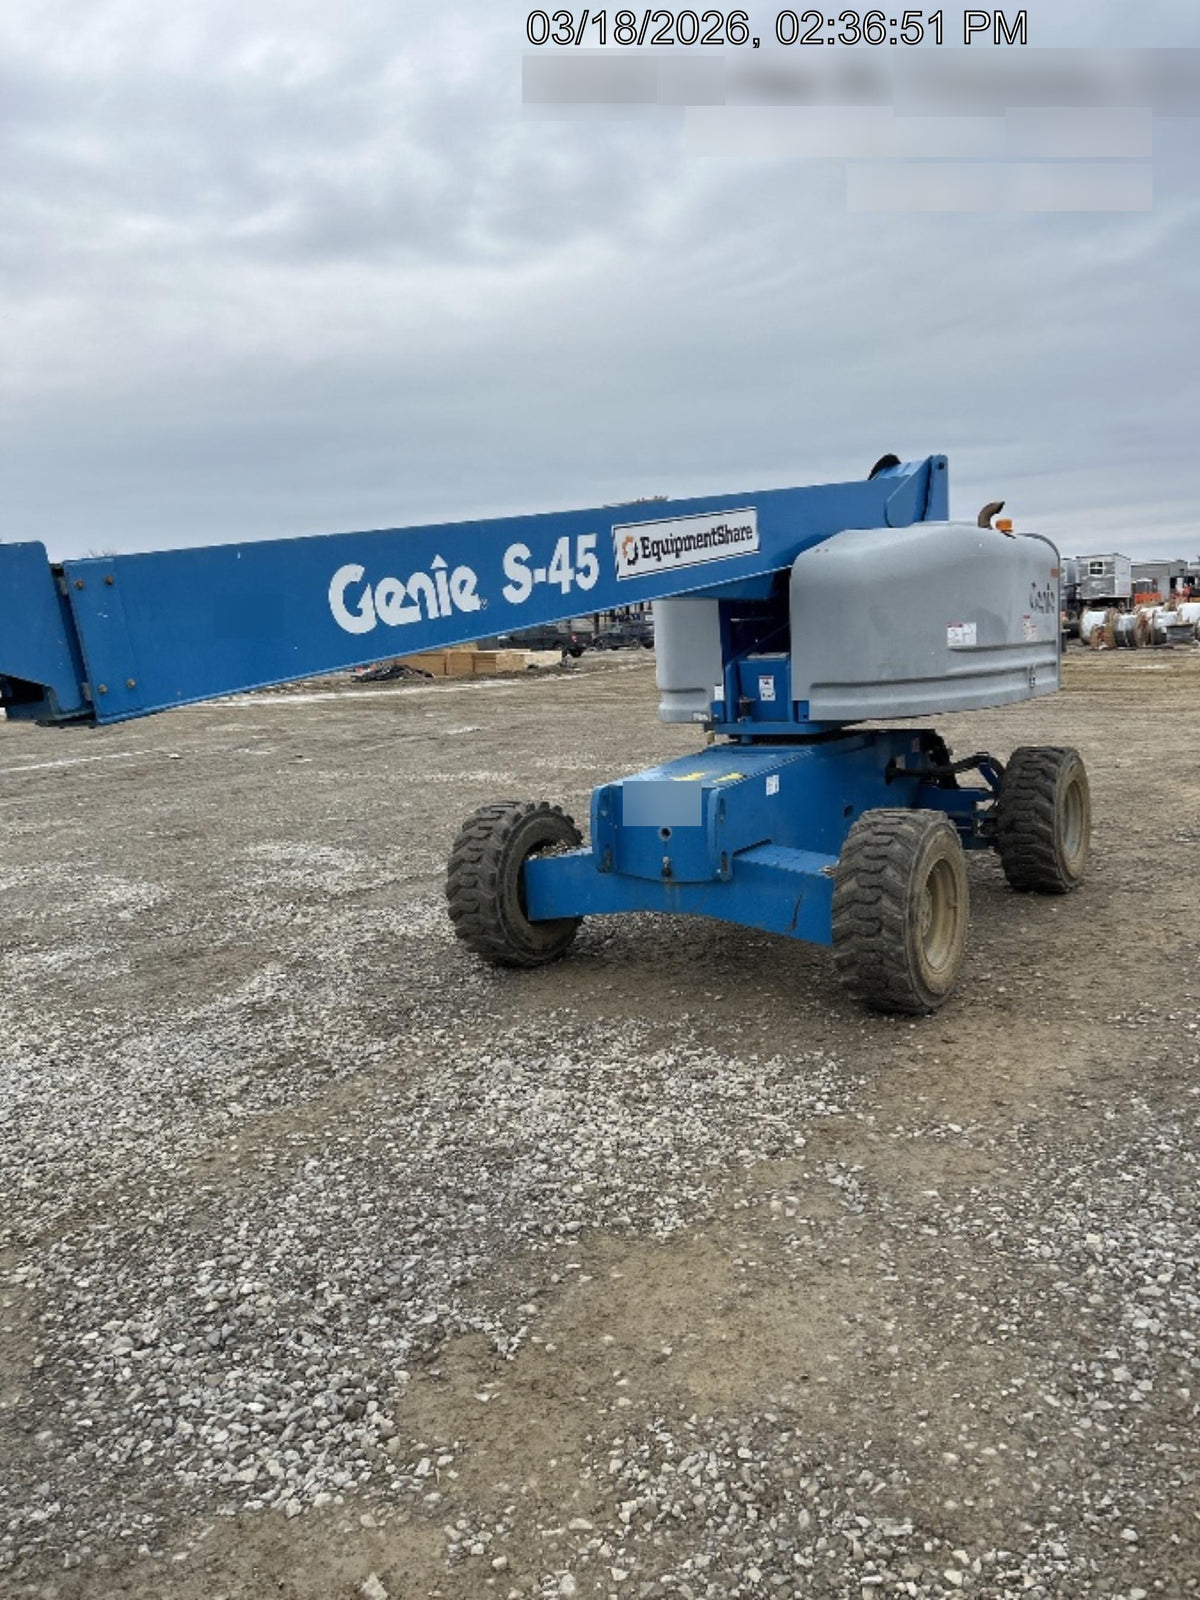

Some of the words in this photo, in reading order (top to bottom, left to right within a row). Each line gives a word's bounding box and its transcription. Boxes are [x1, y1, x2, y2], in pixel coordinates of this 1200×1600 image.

[640, 523, 753, 562] EquipmentShare
[328, 554, 482, 634] Genie
[502, 533, 600, 604] S-45
